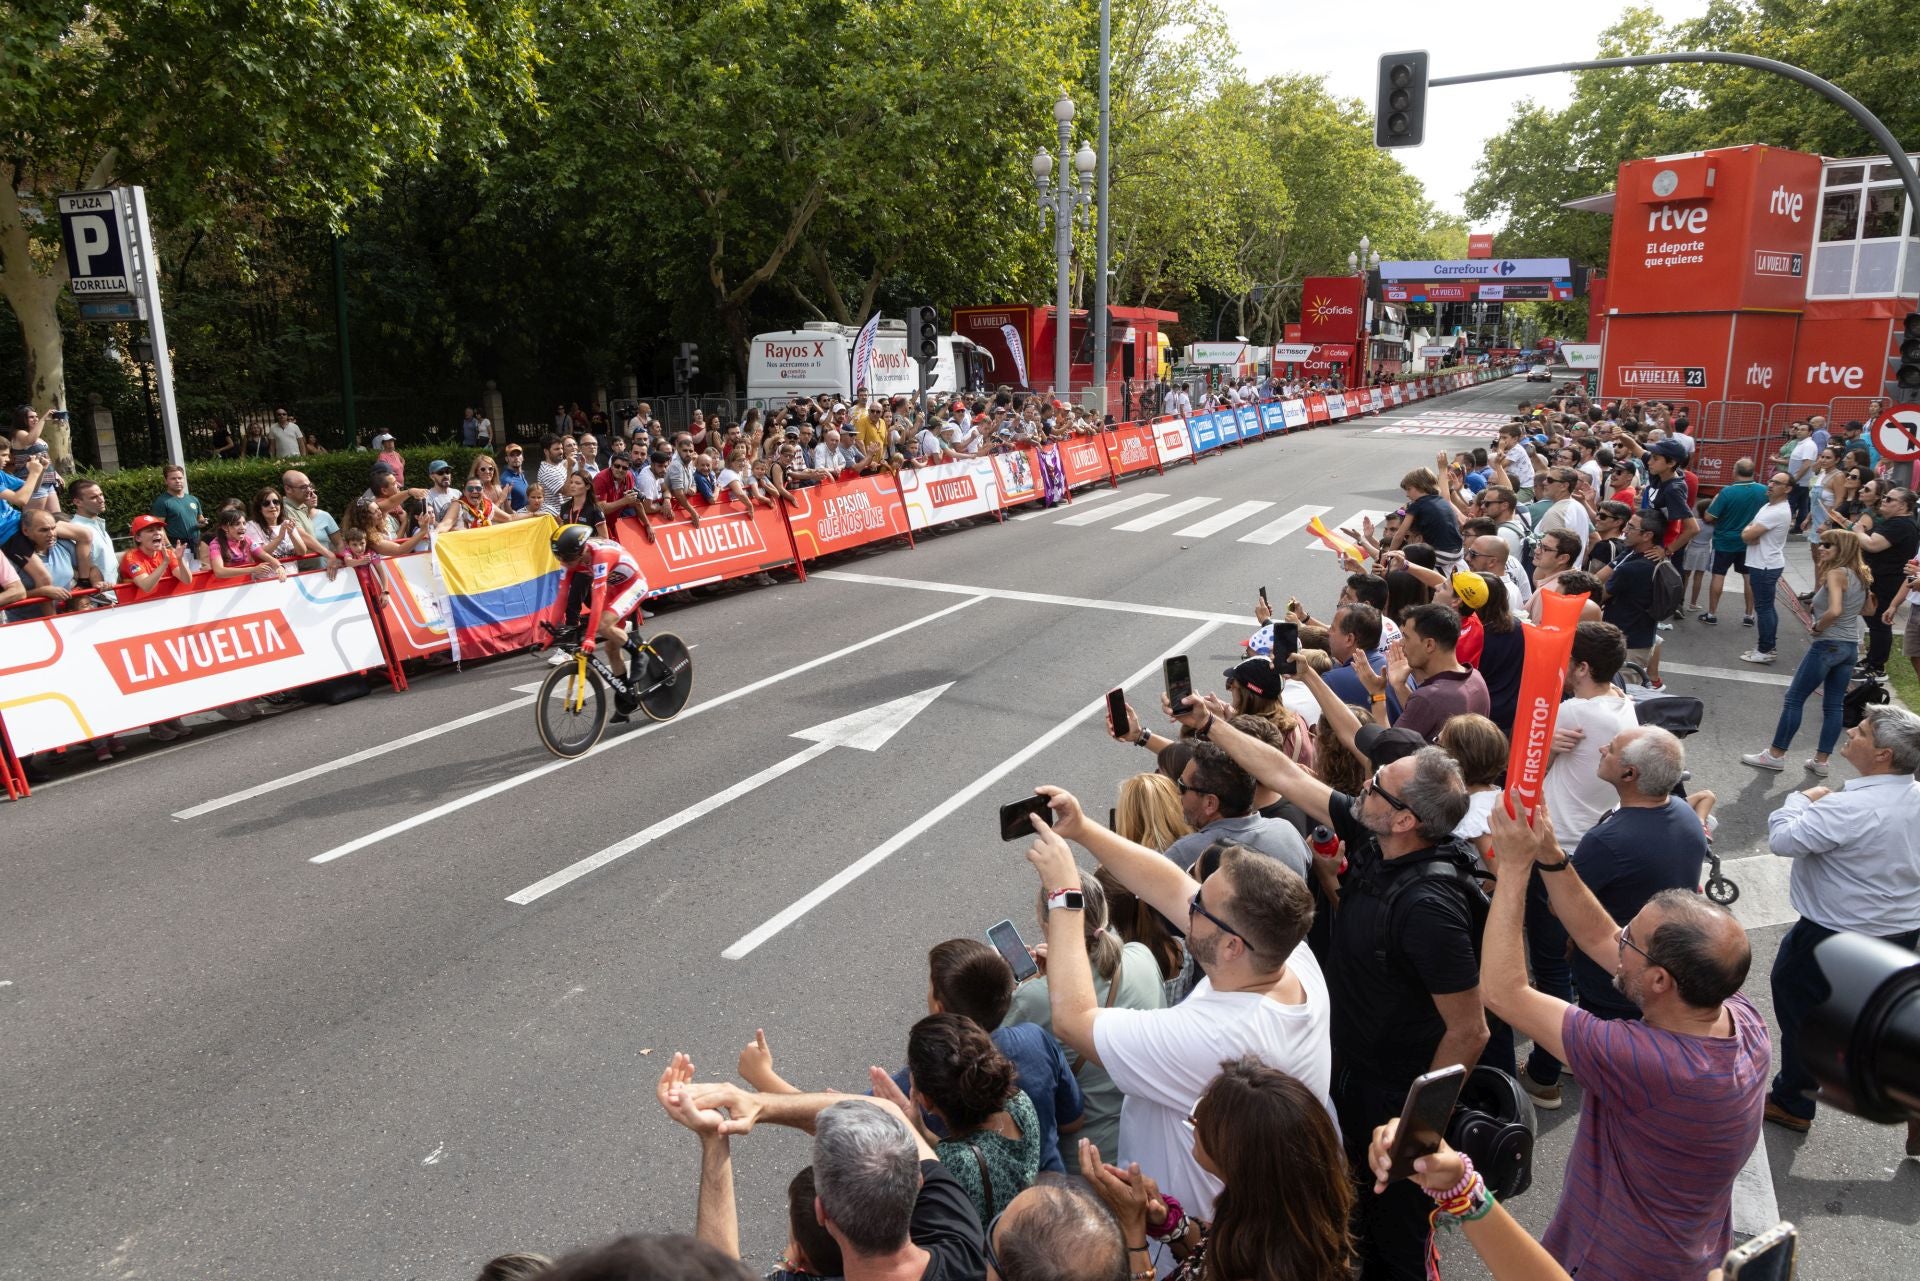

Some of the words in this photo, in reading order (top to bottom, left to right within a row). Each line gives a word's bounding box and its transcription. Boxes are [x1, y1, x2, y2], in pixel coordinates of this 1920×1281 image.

[70, 197, 103, 210] PLAZA
[1769, 185, 1803, 222] rtve
[1648, 205, 1708, 234] rtve
[70, 214, 110, 276] P
[1646, 242, 1658, 254] El
[1659, 240, 1705, 255] deporte
[1433, 264, 1489, 275] Carrefour
[1644, 257, 1663, 268] que
[1665, 254, 1704, 267] quieres
[1757, 254, 1767, 270] LA
[1767, 255, 1790, 271] VUELTA
[1792, 258, 1801, 273] 23
[73, 279, 126, 291] ZORRILLA
[1439, 288, 1461, 296] VUELTA
[1318, 306, 1353, 315] Cofidis
[973, 317, 982, 327] LA
[765, 342, 808, 363] Rayos
[813, 341, 824, 357] X
[871, 348, 900, 373] Rayos
[900, 348, 910, 368] X
[766, 360, 778, 368] Nos
[1806, 361, 1864, 389] rtve
[1624, 370, 1637, 383] LA
[1639, 369, 1680, 383] VUELTA
[1686, 370, 1702, 385] 23
[1746, 362, 1773, 389] rtve
[1072, 452, 1081, 469] LA
[1079, 447, 1099, 467] VUELTA
[931, 485, 945, 504] LA
[941, 480, 974, 501] VUELTA
[823, 498, 838, 518] LA
[836, 490, 871, 514] PASIÓN
[817, 516, 841, 542] QUE
[840, 511, 864, 536] NOS
[862, 505, 886, 530] UNE
[665, 531, 693, 562] LA
[689, 520, 755, 556] VUELTA
[120, 643, 169, 684] LA
[164, 618, 286, 673] VUELTA
[1523, 696, 1550, 783] FIRSTSTOP
